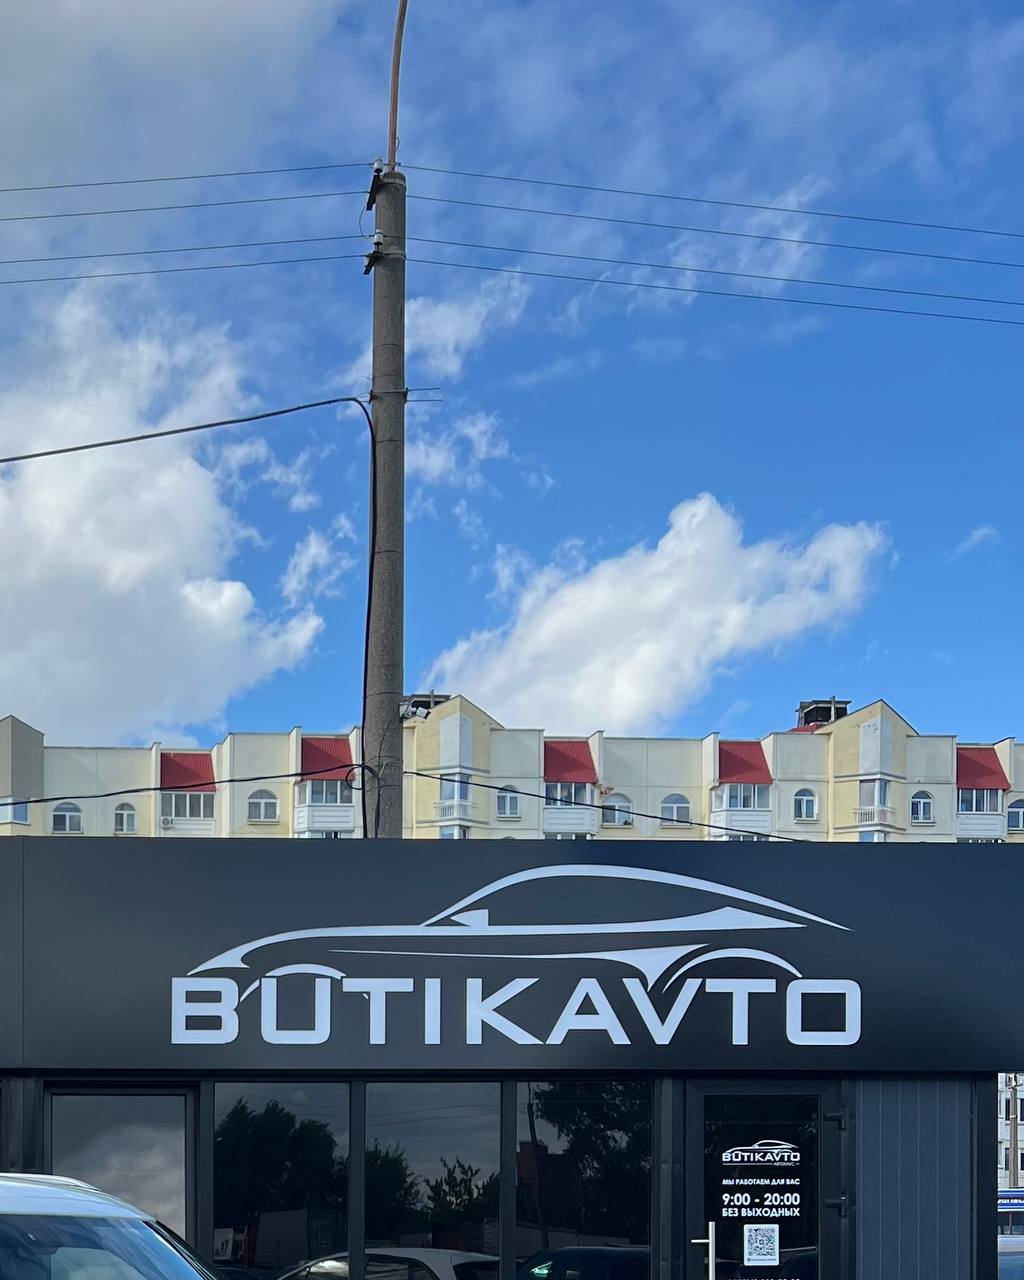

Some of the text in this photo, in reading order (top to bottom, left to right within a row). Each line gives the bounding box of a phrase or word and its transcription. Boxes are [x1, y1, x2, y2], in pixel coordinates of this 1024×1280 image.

[170, 975, 863, 1047] BUTIKAVTO
[721, 1152, 801, 1162] BUTIKAVTO
[721, 1178, 801, 1186] МЫ РАБОТАЕМ ДЛЯ ВАС
[722, 1193, 751, 1206] 9:00
[764, 1193, 801, 1206] 20:00
[722, 1208, 801, 1219] БЕЗ ВЫХОДНЫХ
